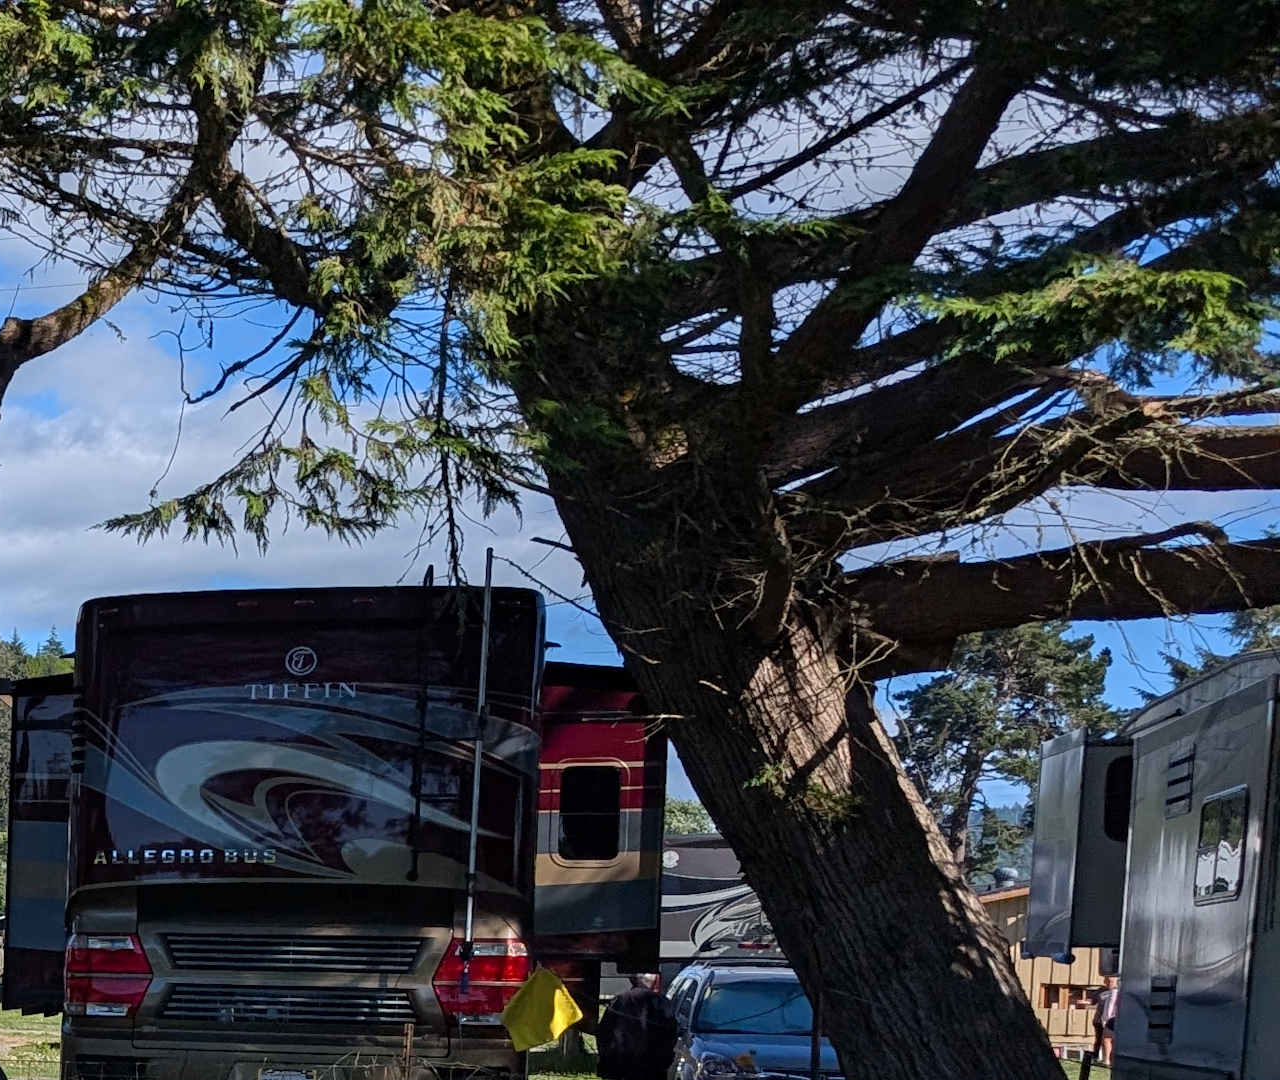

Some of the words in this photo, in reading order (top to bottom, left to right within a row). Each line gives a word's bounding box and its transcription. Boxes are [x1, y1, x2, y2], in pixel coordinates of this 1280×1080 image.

[244, 682, 359, 700] TIFFIN
[93, 848, 214, 865] ALLEGRO
[223, 848, 277, 865] BUS
